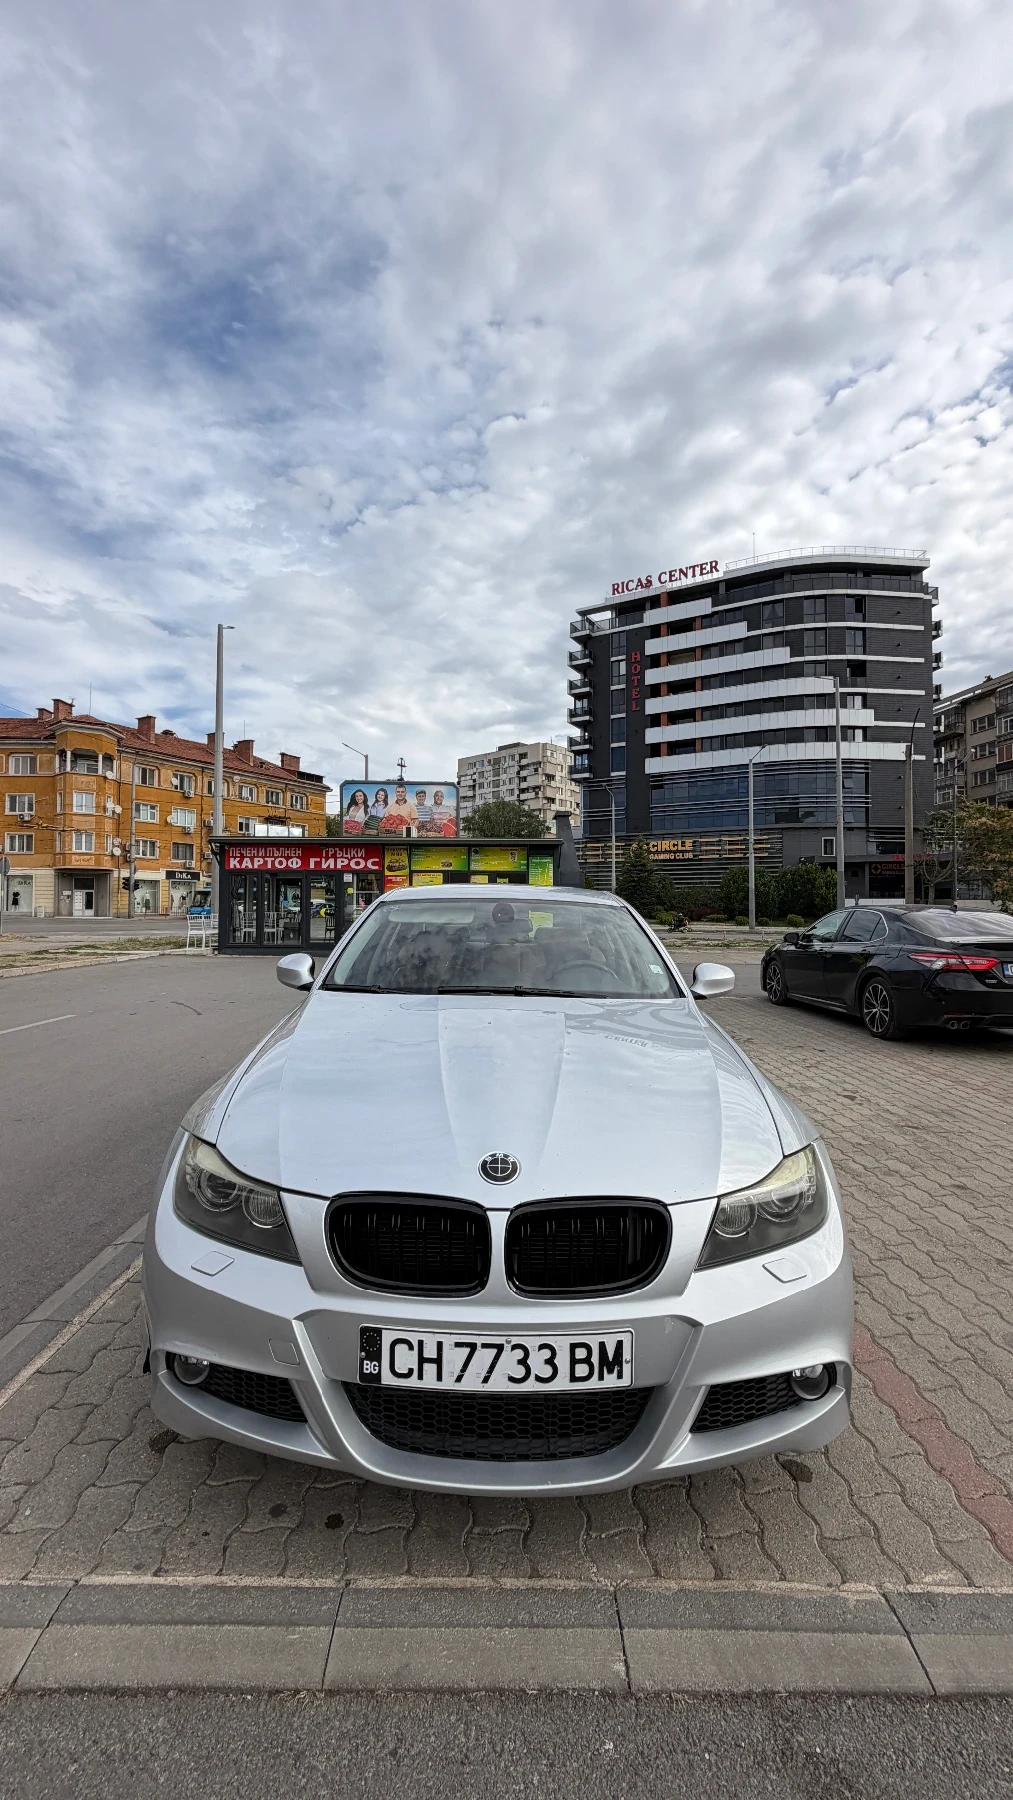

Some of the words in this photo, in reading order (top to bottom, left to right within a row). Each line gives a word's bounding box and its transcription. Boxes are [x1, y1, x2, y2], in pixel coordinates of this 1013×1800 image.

[611, 575, 653, 596] RICAS
[657, 560, 719, 585] CENTER
[631, 651, 641, 711] HOTEL
[649, 840, 693, 851] CIRCLE
[229, 847, 257, 857] ПЕЧЕН
[258, 848, 265, 857] И
[266, 847, 302, 857] ПЪЛНЕН
[322, 847, 366, 859] ГРЪЦКИ
[229, 857, 302, 869] КАРТОФ
[309, 857, 380, 870] ГИРОС
[362, 1360, 379, 1374] BG
